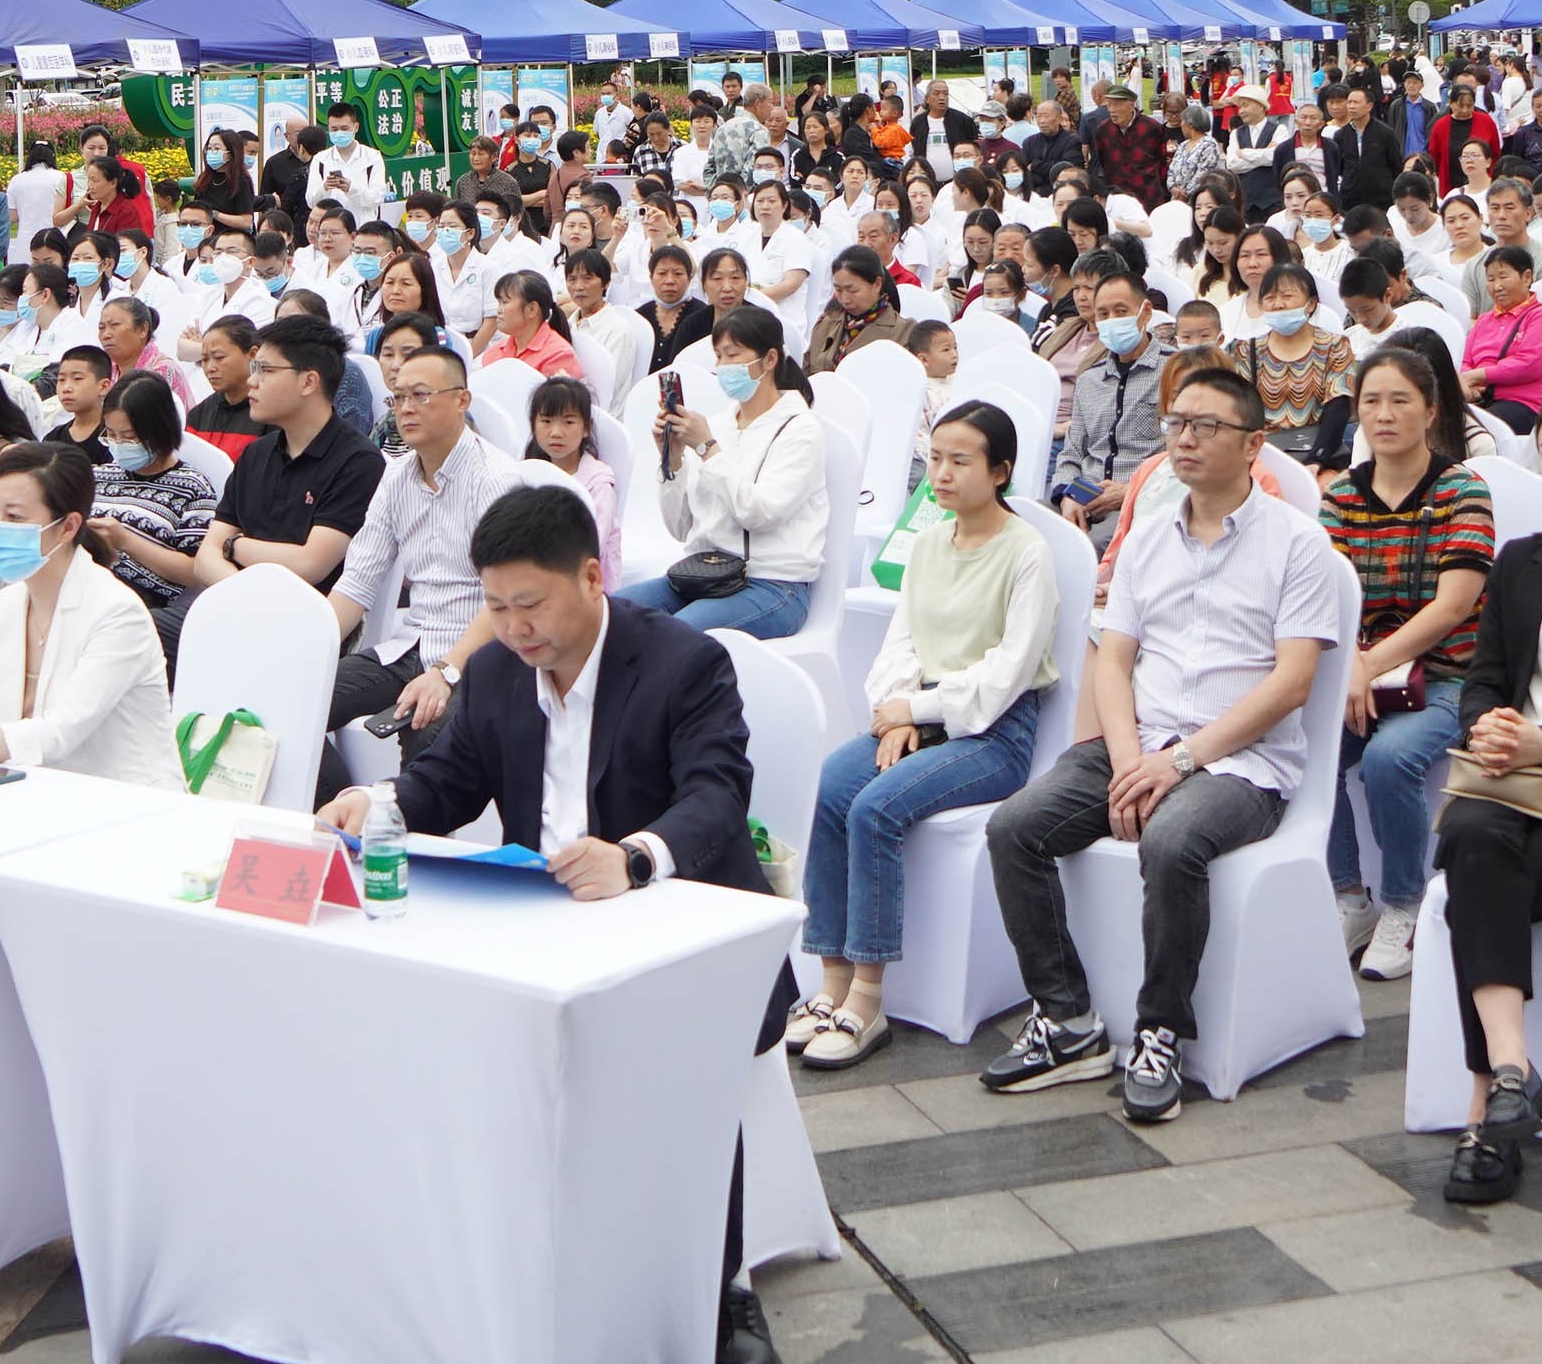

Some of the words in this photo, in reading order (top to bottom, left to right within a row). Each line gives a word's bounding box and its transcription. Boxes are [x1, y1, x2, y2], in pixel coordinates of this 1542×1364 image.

[316, 81, 343, 105] 平等
[377, 88, 403, 109] 公正
[377, 113, 404, 136] 法治
